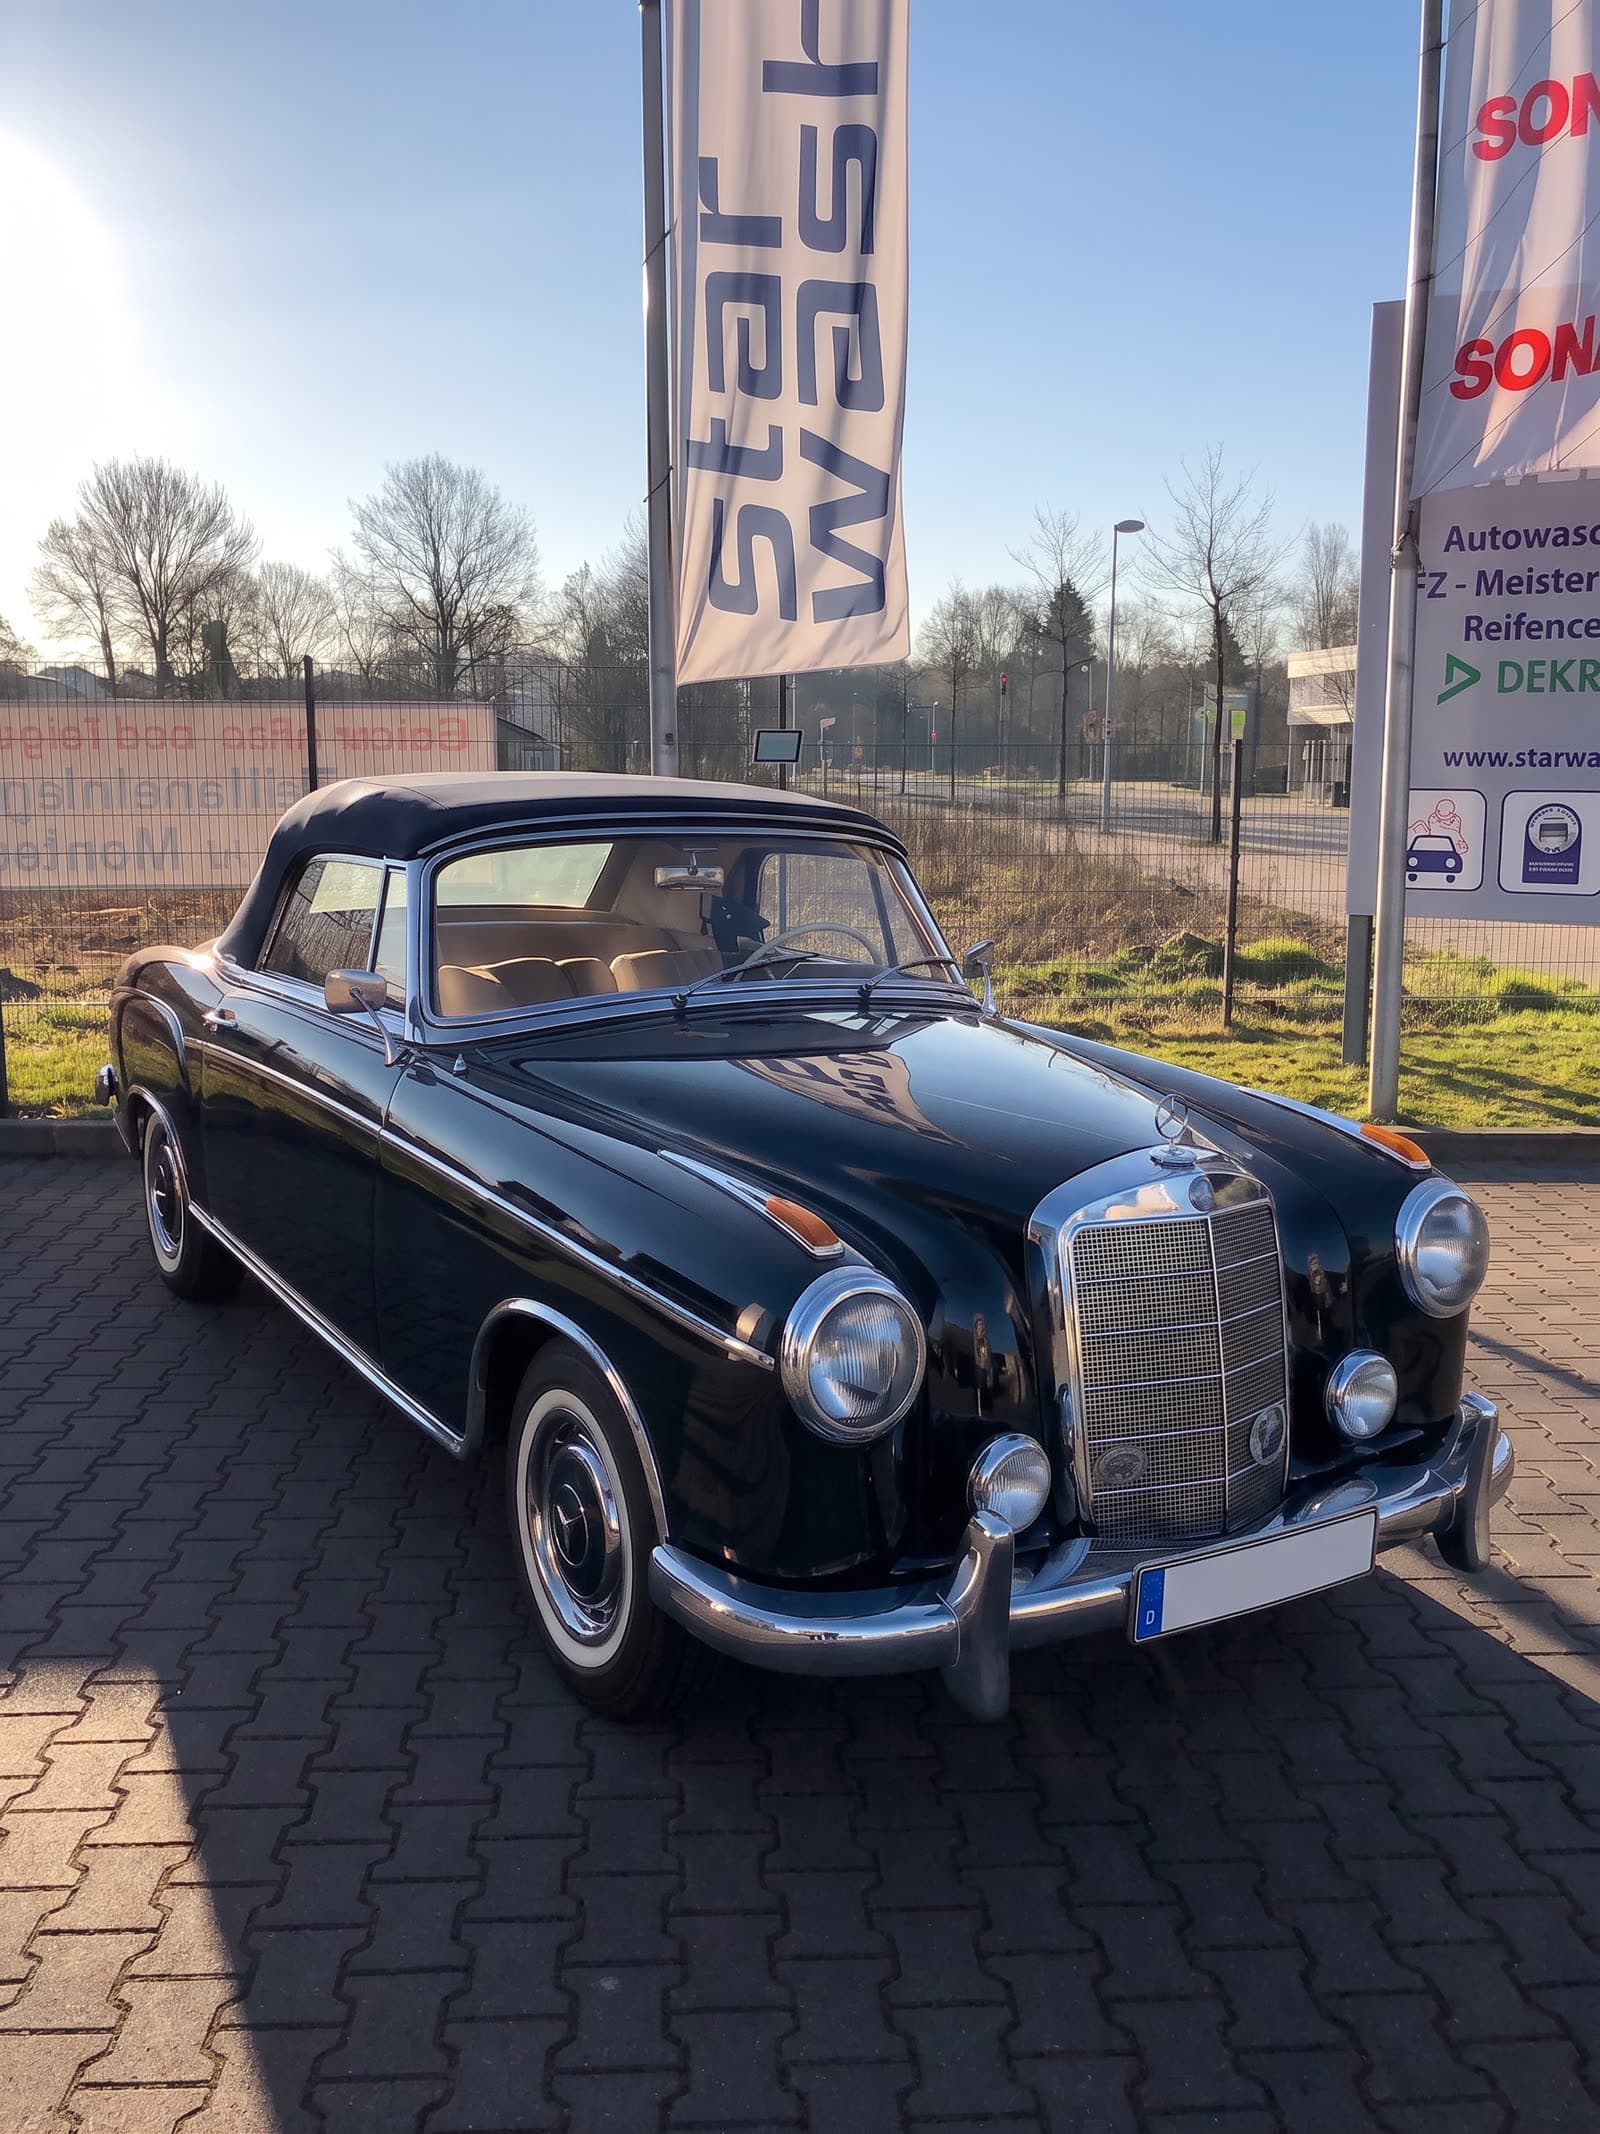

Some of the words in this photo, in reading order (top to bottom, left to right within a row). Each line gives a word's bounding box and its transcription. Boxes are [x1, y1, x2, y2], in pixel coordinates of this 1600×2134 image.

[1450, 315, 1600, 400] SON
[687, 156, 797, 622] star
[1475, 567, 1599, 597] Meister
[1464, 612, 1600, 641] Reifence
[1497, 659, 1600, 693] DEKR
[1443, 748, 1600, 768] www.starwa
[1146, 1610, 1155, 1625] D
